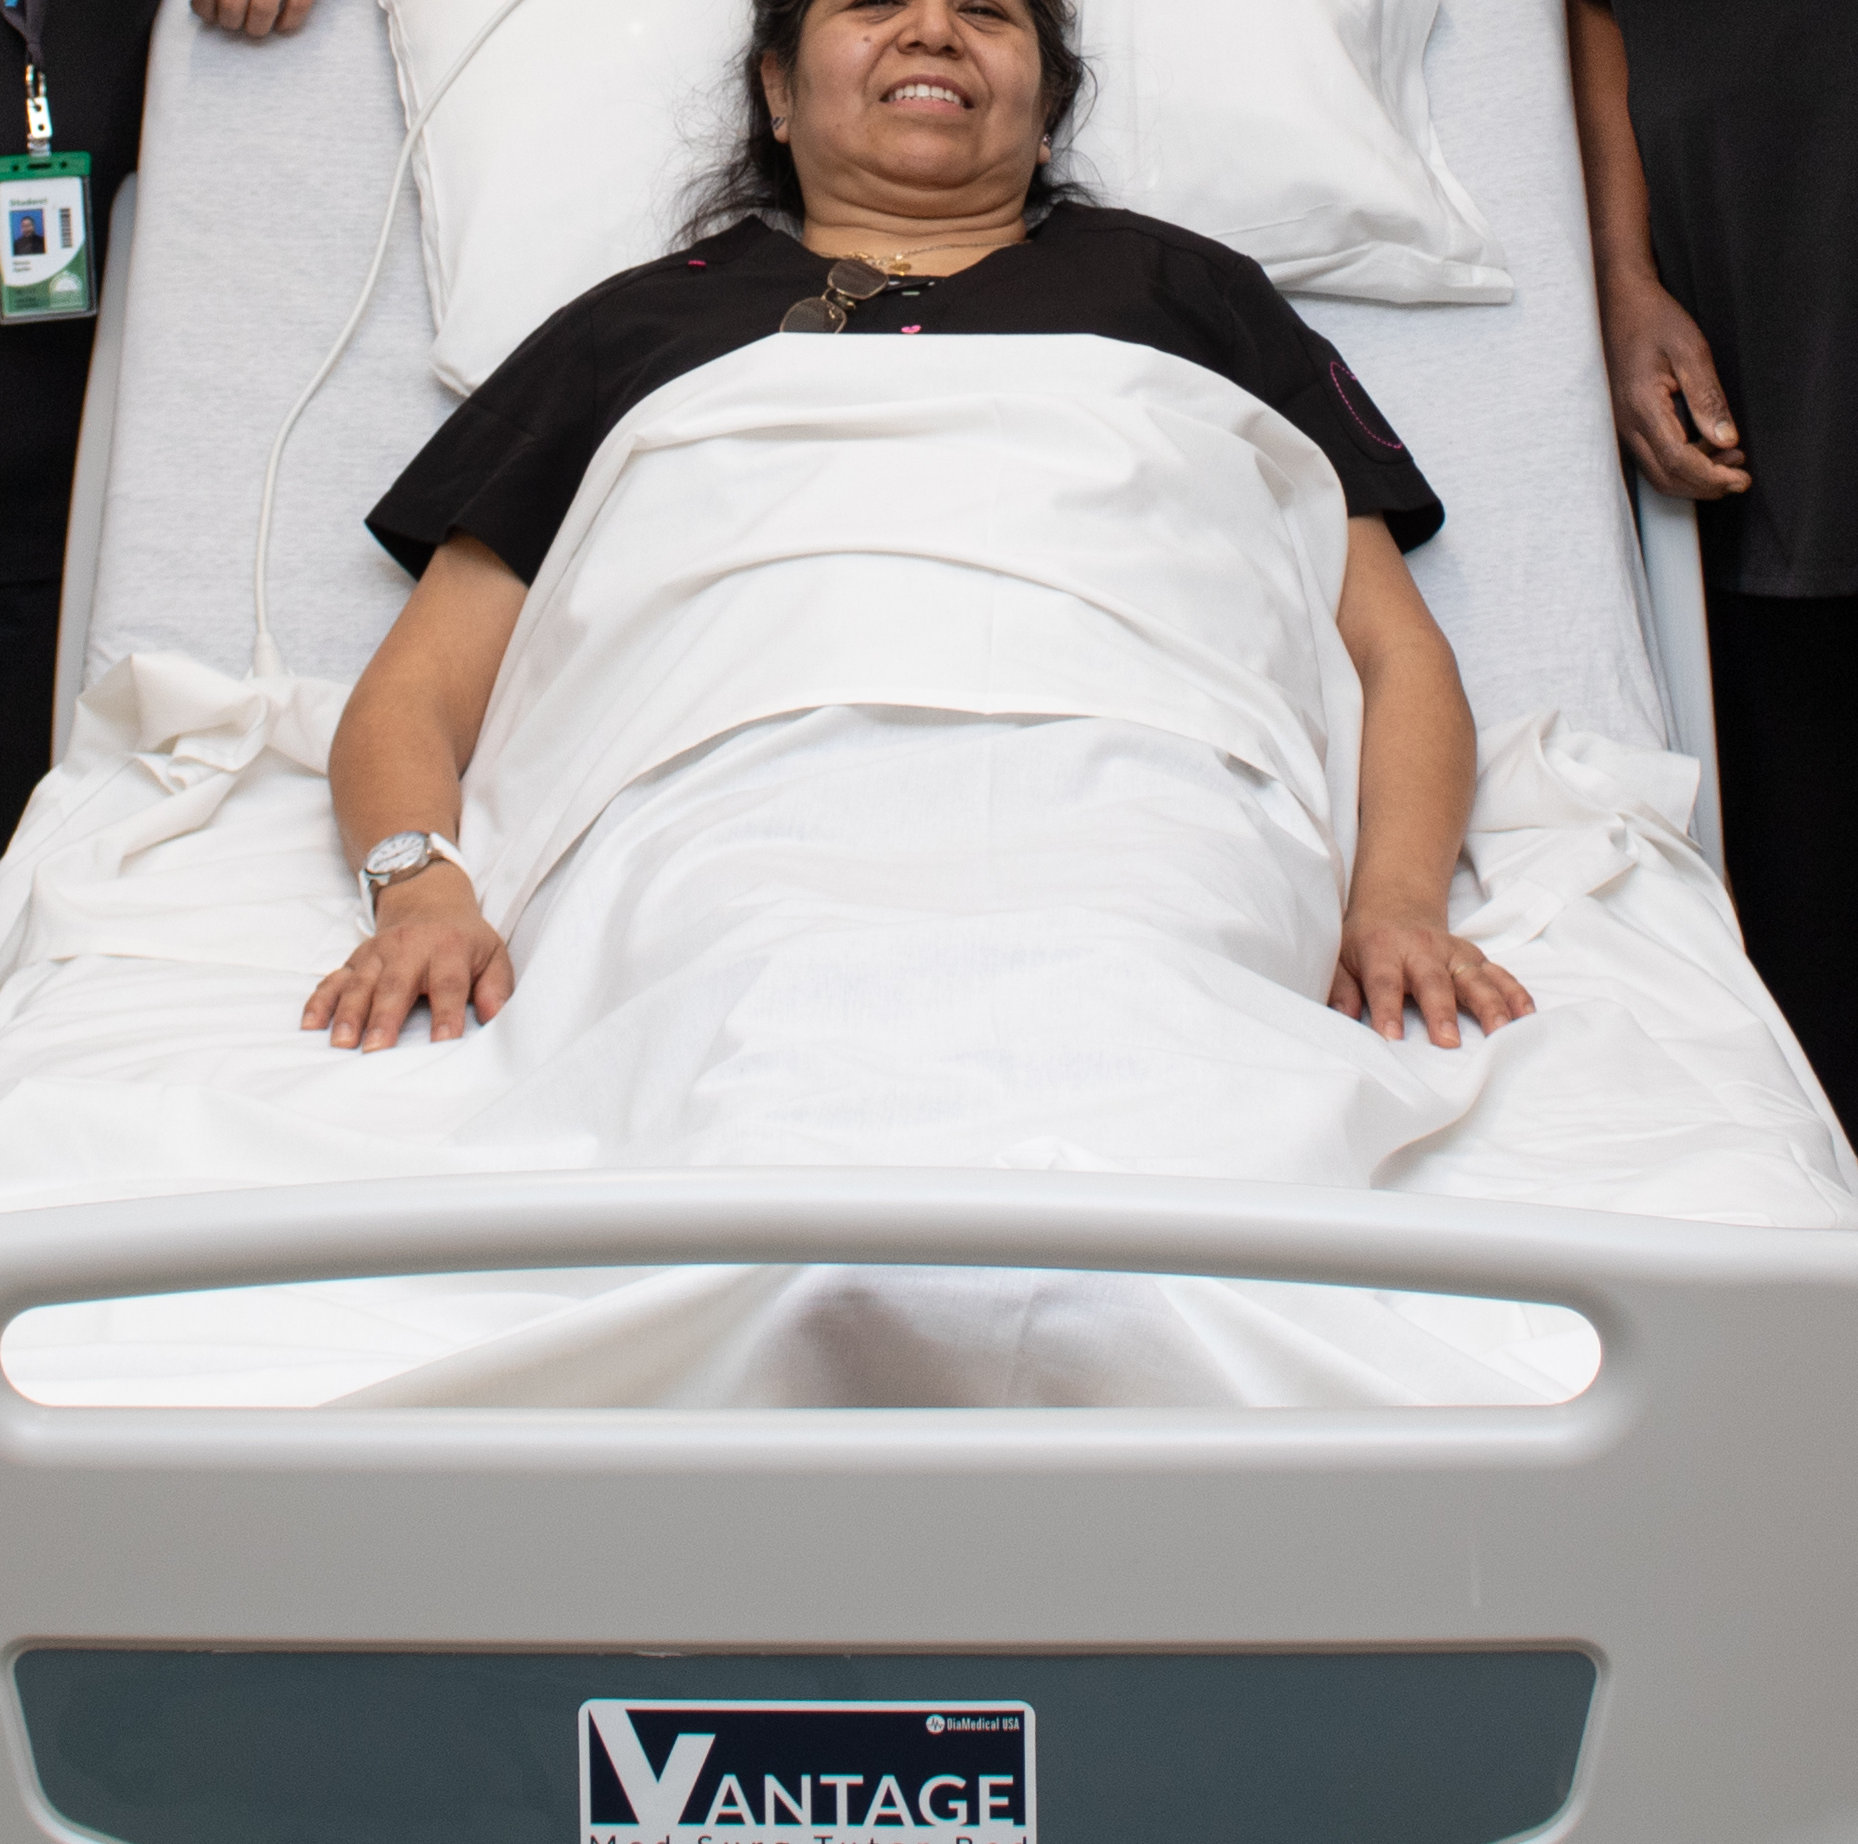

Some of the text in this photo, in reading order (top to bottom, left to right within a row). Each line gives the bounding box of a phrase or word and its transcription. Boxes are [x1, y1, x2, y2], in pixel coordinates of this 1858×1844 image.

[946, 1716, 1020, 1732] DiaMedical USA
[588, 1709, 1014, 1827] VANTAGE
